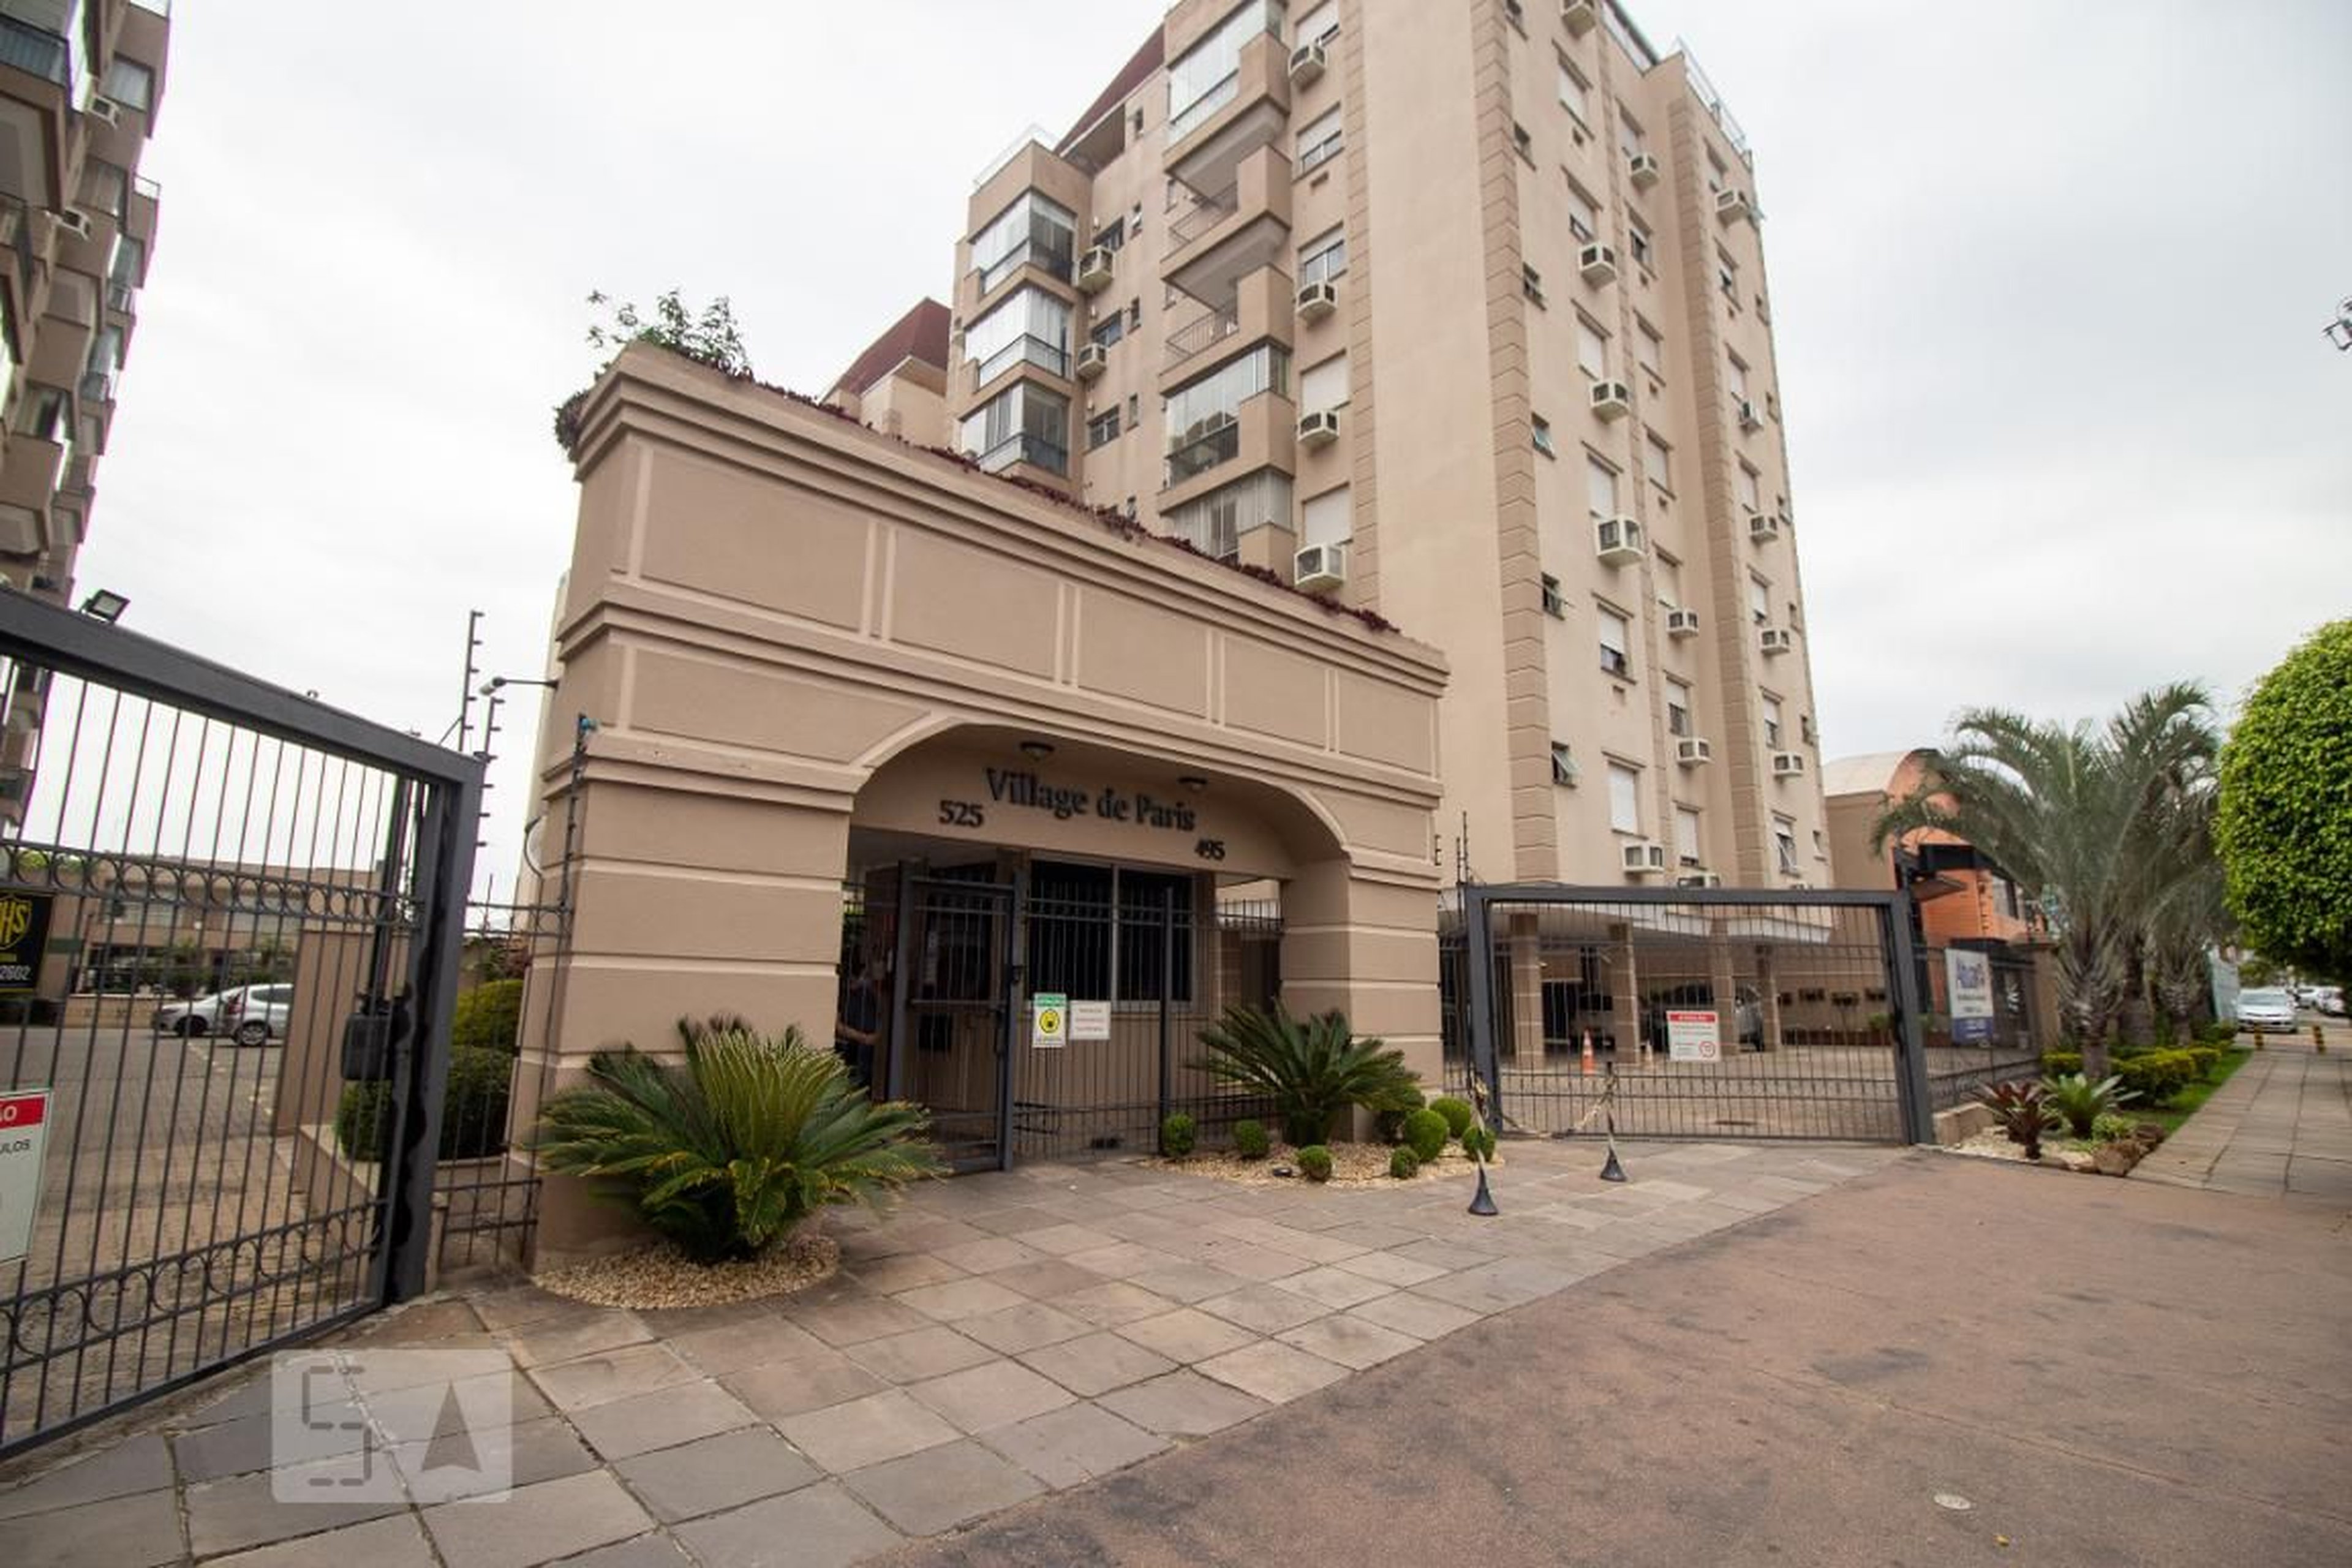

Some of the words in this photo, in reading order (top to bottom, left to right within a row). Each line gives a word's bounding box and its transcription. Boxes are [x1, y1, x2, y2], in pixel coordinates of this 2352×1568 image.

[987, 767, 1088, 820] Village
[1096, 788, 1128, 821] de
[1136, 793, 1196, 831] Paris
[938, 800, 984, 828] 525
[1195, 839, 1226, 861] 495
[0, 900, 27, 944] HS
[0, 1104, 17, 1122] O
